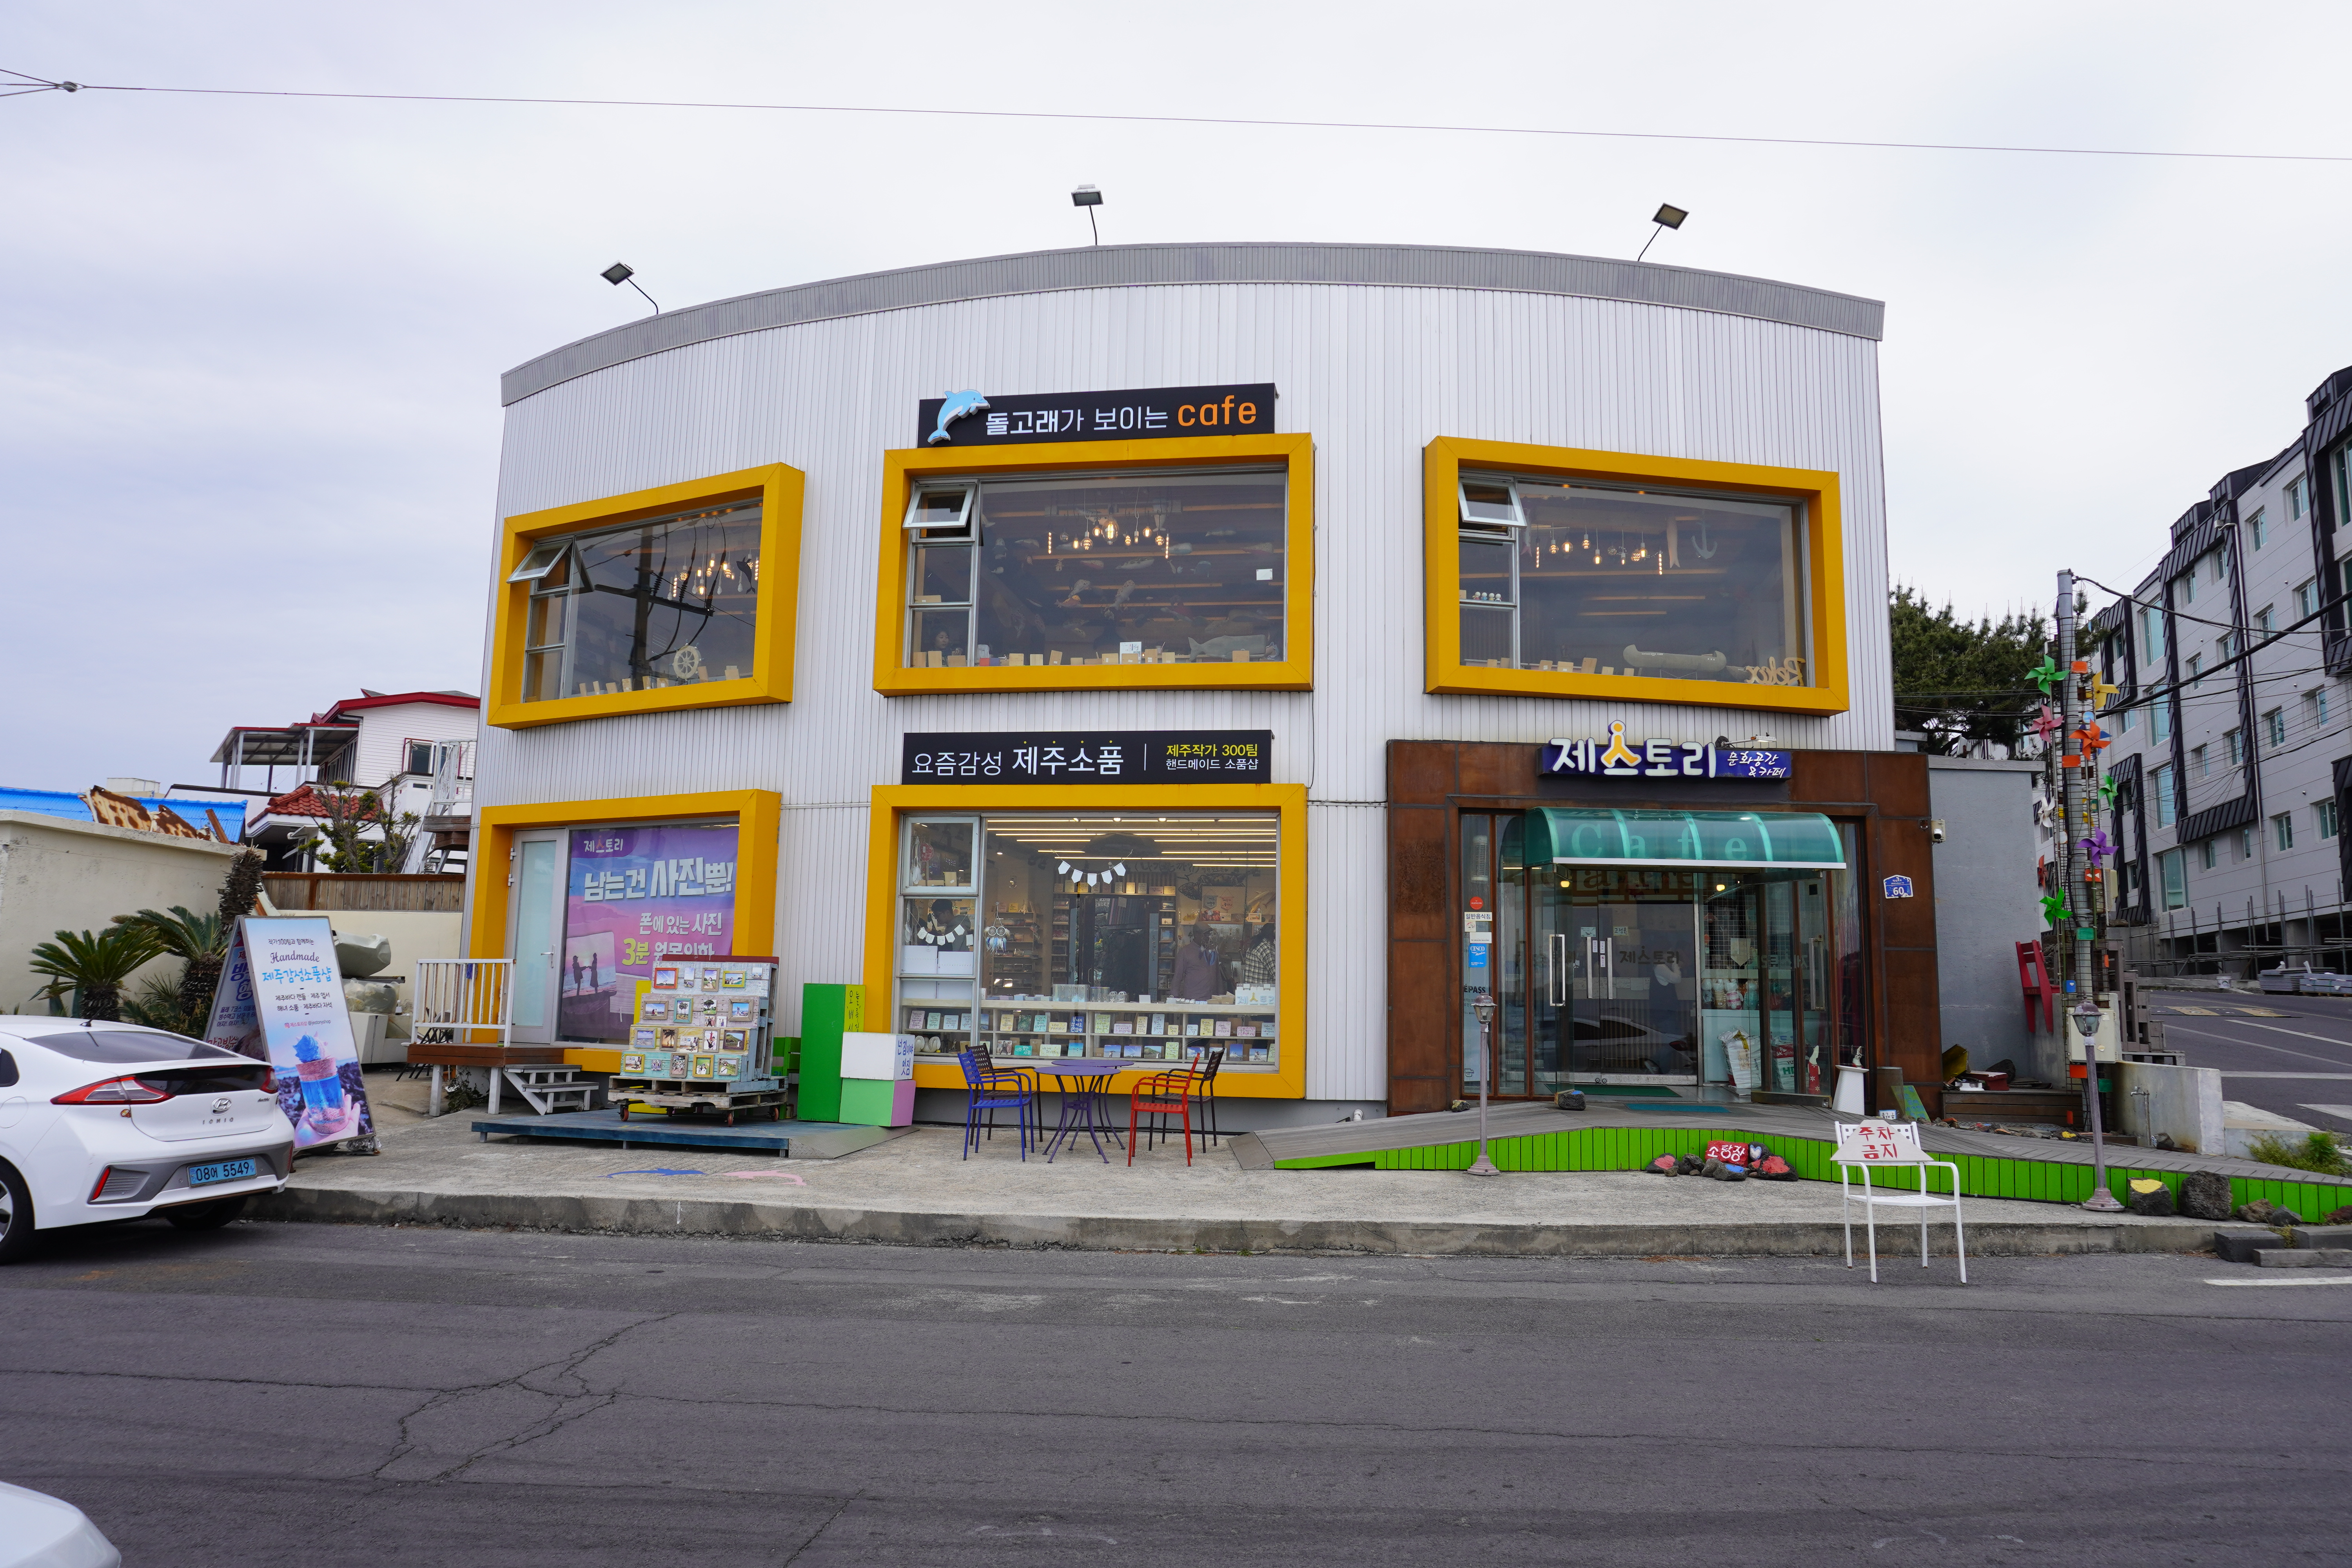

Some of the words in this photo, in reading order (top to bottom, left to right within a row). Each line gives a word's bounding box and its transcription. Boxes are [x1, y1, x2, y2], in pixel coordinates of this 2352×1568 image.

[985, 408, 1085, 436] 돌고래가
[1093, 406, 1168, 431] 보이는
[1178, 394, 1257, 427] cafe
[1166, 743, 1218, 757] 제주작가
[1222, 743, 1258, 757] 300팀
[1549, 720, 1717, 779] 제스토리
[911, 751, 1002, 776] 요즘감성
[1012, 746, 1124, 775] 제주소품
[1166, 758, 1220, 771] 핸드메이드
[1727, 751, 1779, 766] 문화공간
[584, 836, 623, 853] 제스토리
[584, 868, 645, 901] 남는건
[650, 857, 734, 897] 사진뿐!
[1893, 886, 1904, 895] 60
[639, 912, 664, 935] 폰에
[666, 915, 690, 935] 있는
[691, 912, 722, 936] 사진
[270, 950, 320, 964] Handmade
[622, 937, 650, 965] 3분
[1619, 945, 1680, 965] 제스토리
[1858, 1126, 1895, 1142] 주차
[1861, 1143, 1898, 1159] 금지
[223, 1161, 249, 1178] 5549
